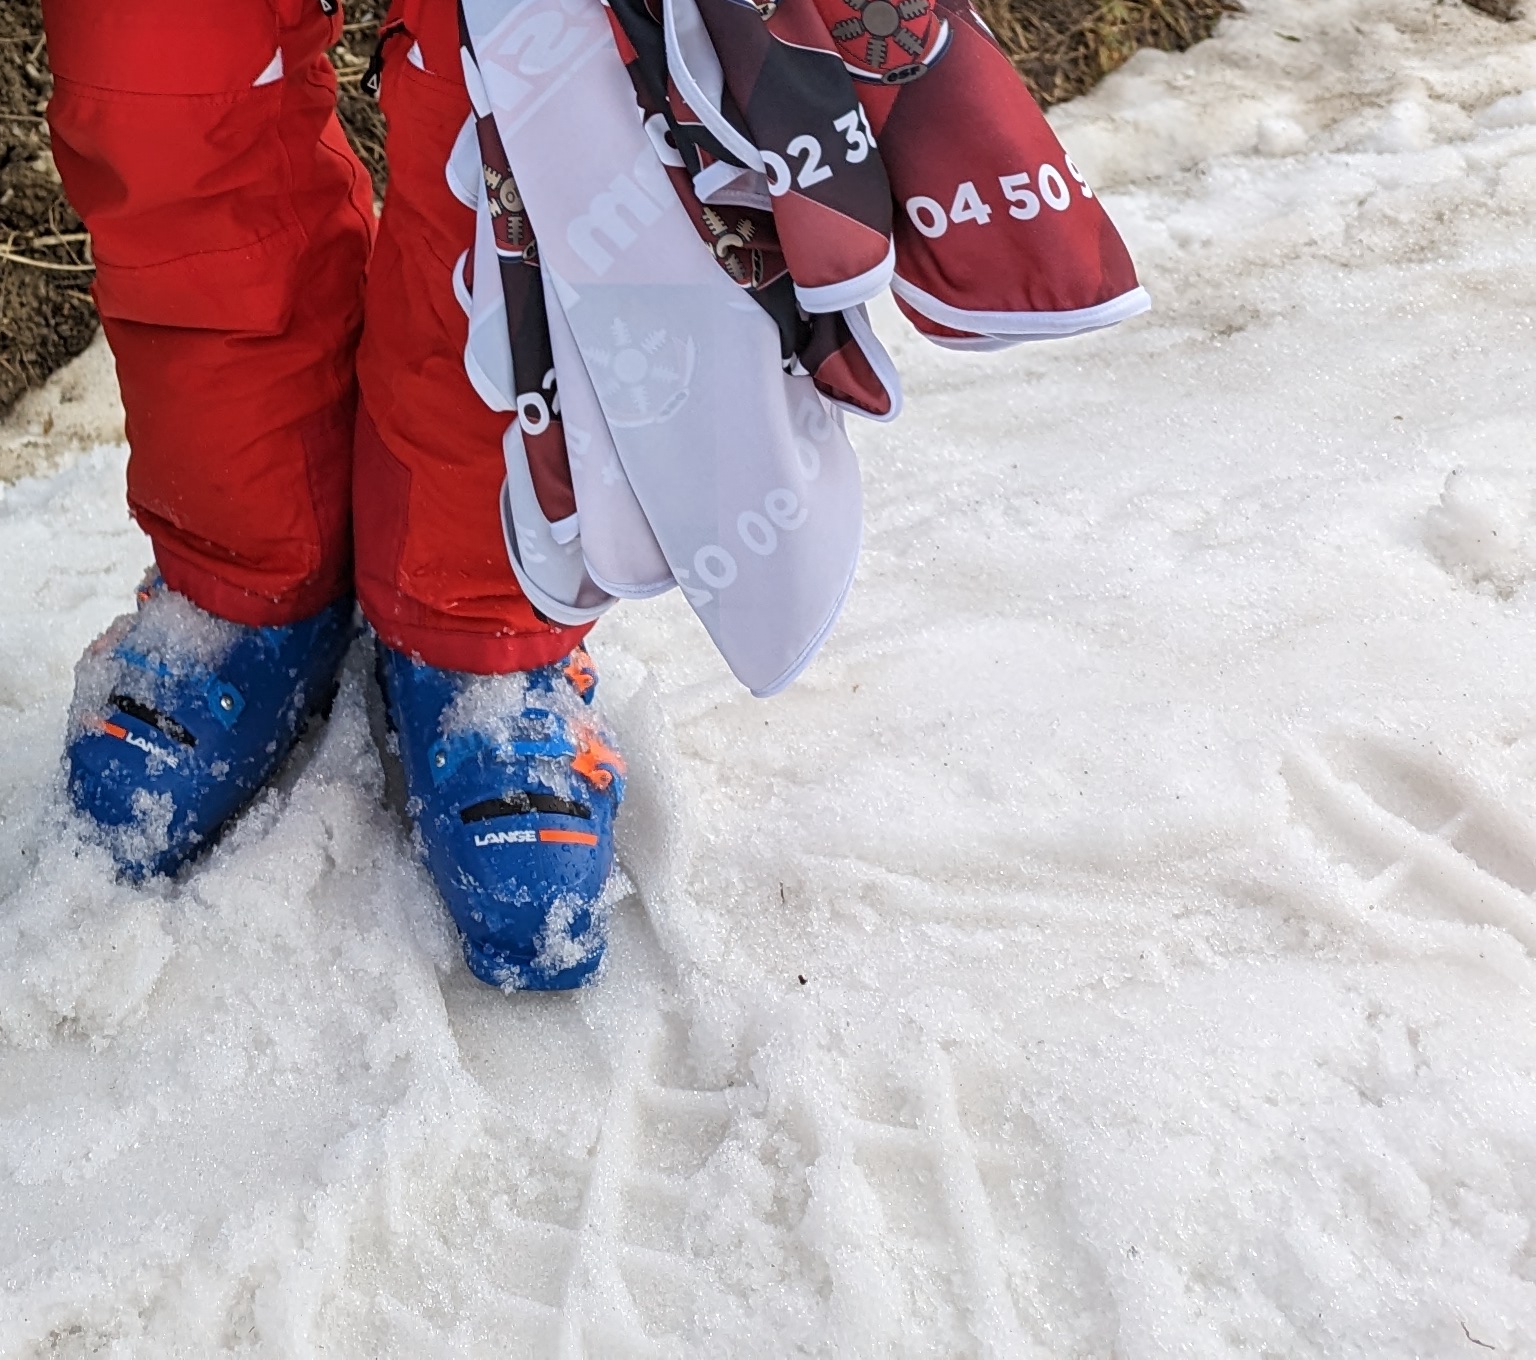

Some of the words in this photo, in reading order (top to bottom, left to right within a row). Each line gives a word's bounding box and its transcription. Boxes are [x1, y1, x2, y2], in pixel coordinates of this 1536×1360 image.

[905, 179, 993, 239] 04
[997, 162, 1072, 221] 50
[473, 829, 538, 847] LANGE
